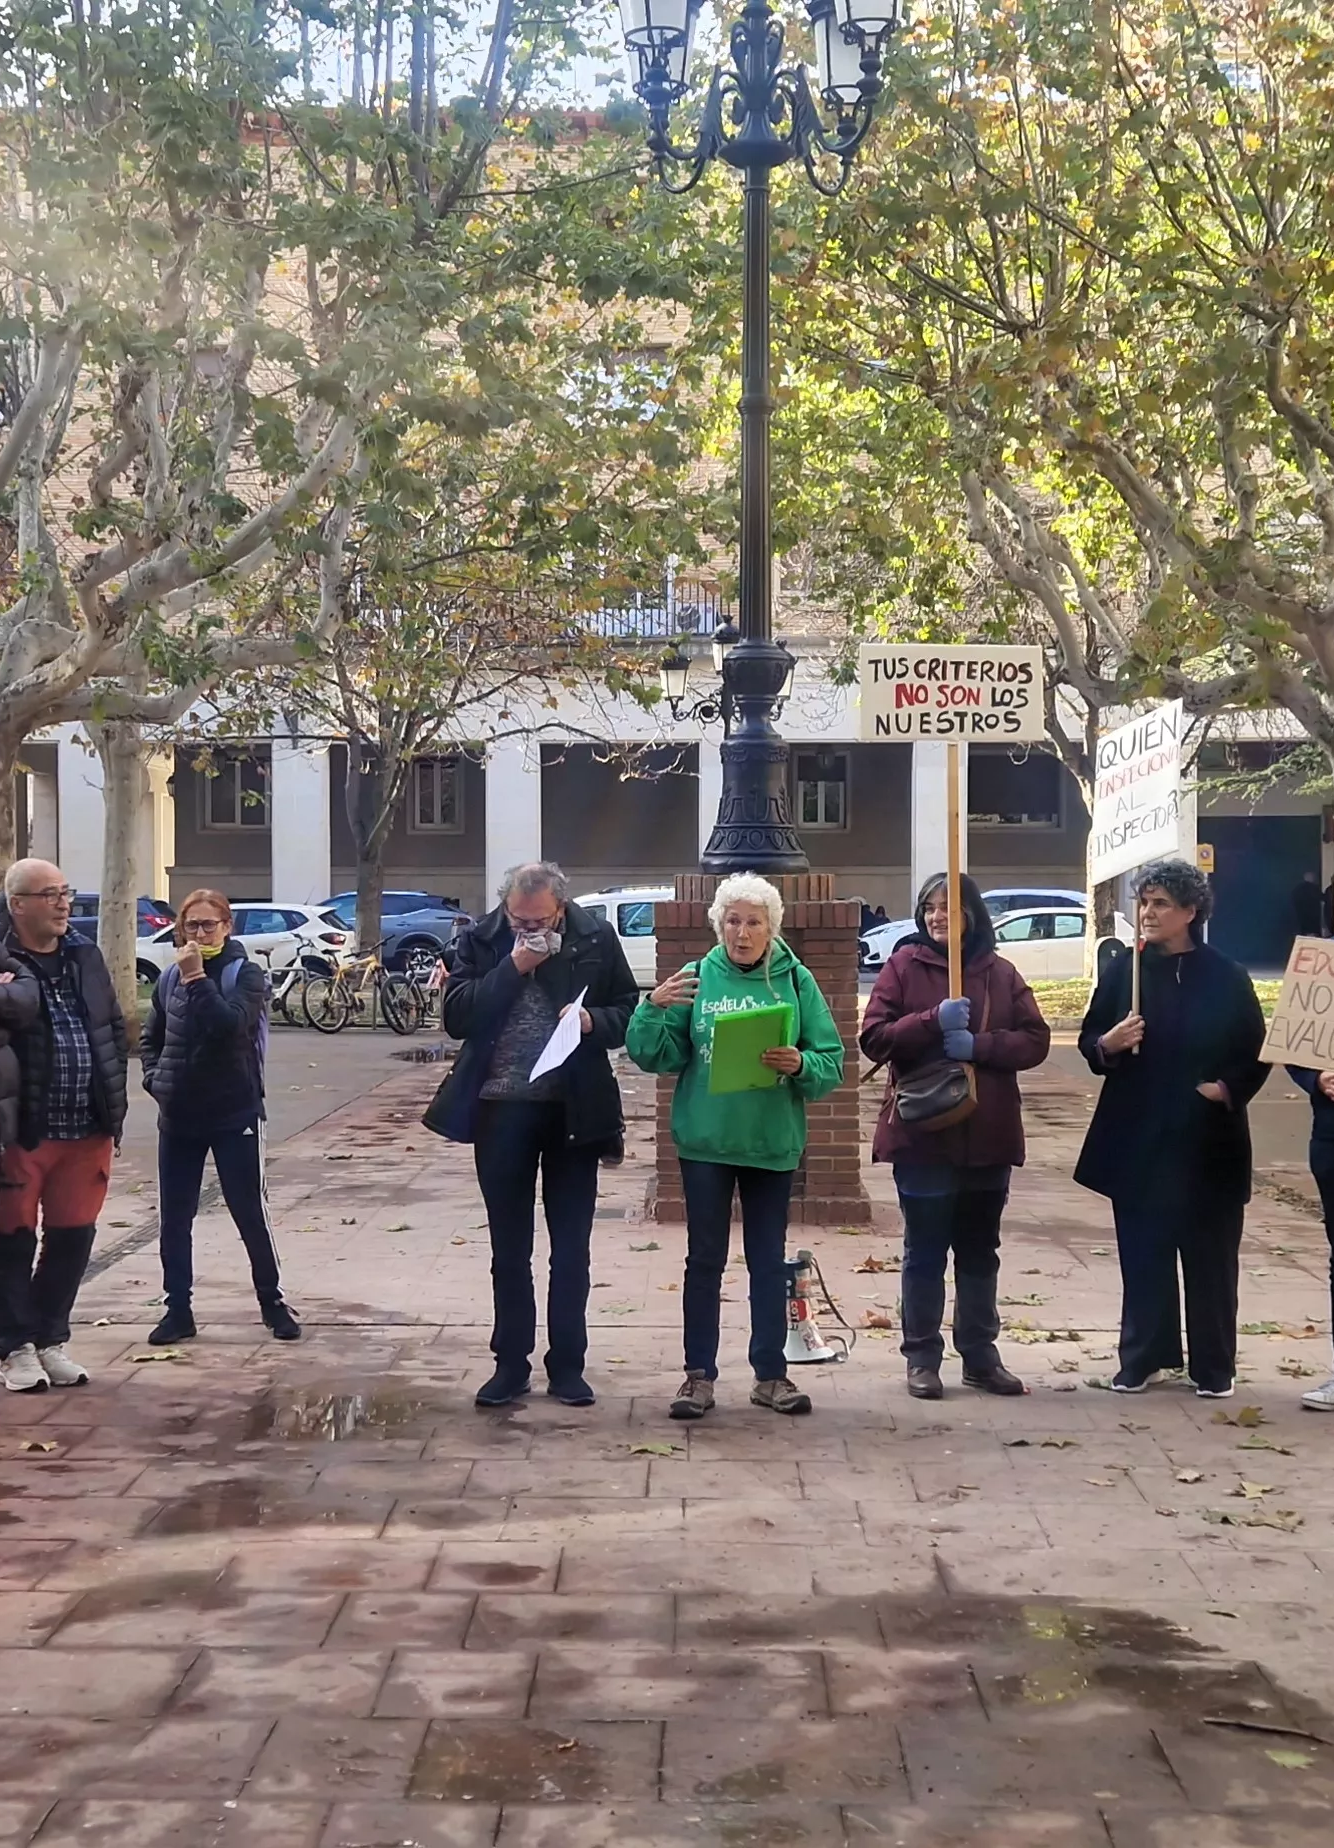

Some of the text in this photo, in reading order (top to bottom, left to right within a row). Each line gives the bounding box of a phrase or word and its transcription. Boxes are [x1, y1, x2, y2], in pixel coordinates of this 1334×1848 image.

[868, 657, 1033, 684] TUS CRITERIOS
[895, 683, 1029, 709] NO SON LOS
[875, 711, 1021, 735] NUESTROS
[1116, 791, 1147, 819] AL
[1096, 789, 1180, 857] INSPECTOR?
[701, 995, 747, 1014] ESCUELA
[1288, 980, 1333, 1015] NO
